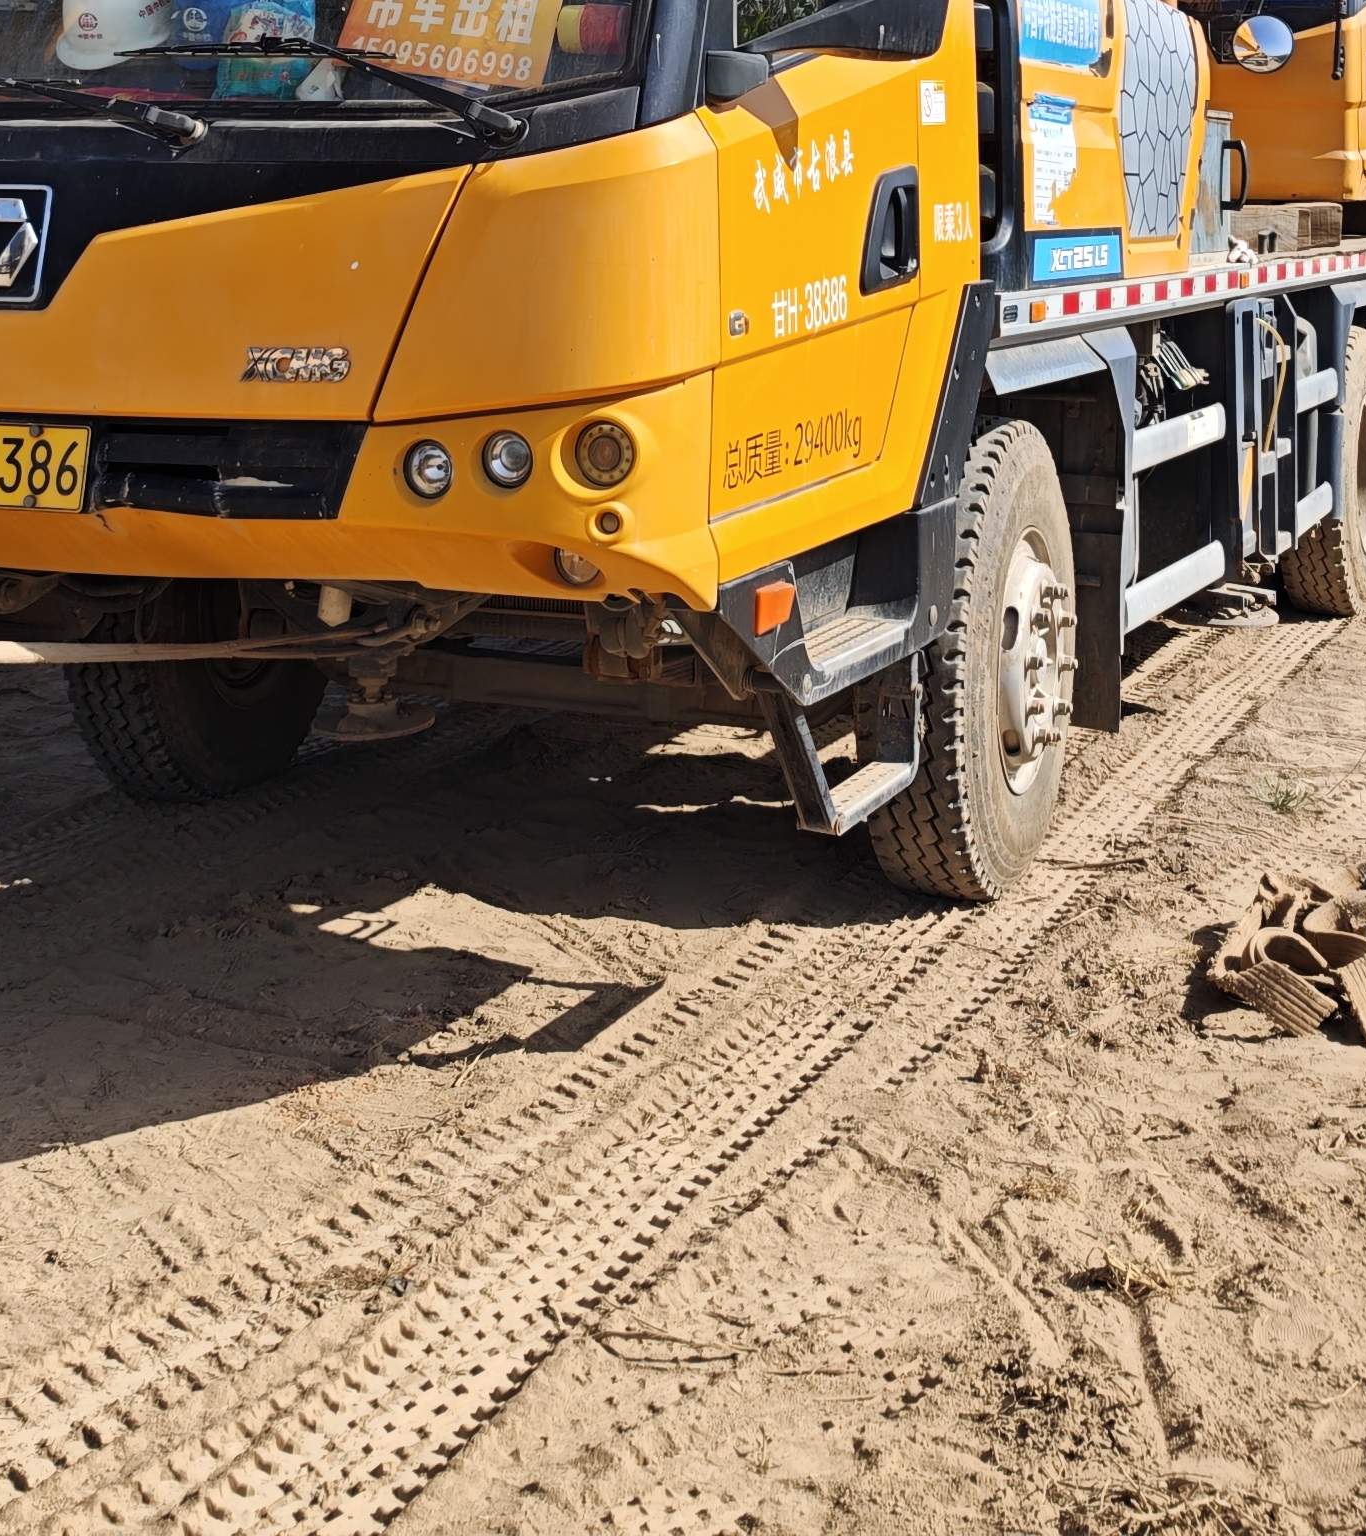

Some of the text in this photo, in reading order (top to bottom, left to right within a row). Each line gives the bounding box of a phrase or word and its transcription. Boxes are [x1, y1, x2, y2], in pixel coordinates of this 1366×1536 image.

[933, 200, 974, 244] 限乘3人
[240, 347, 351, 383] XCMG
